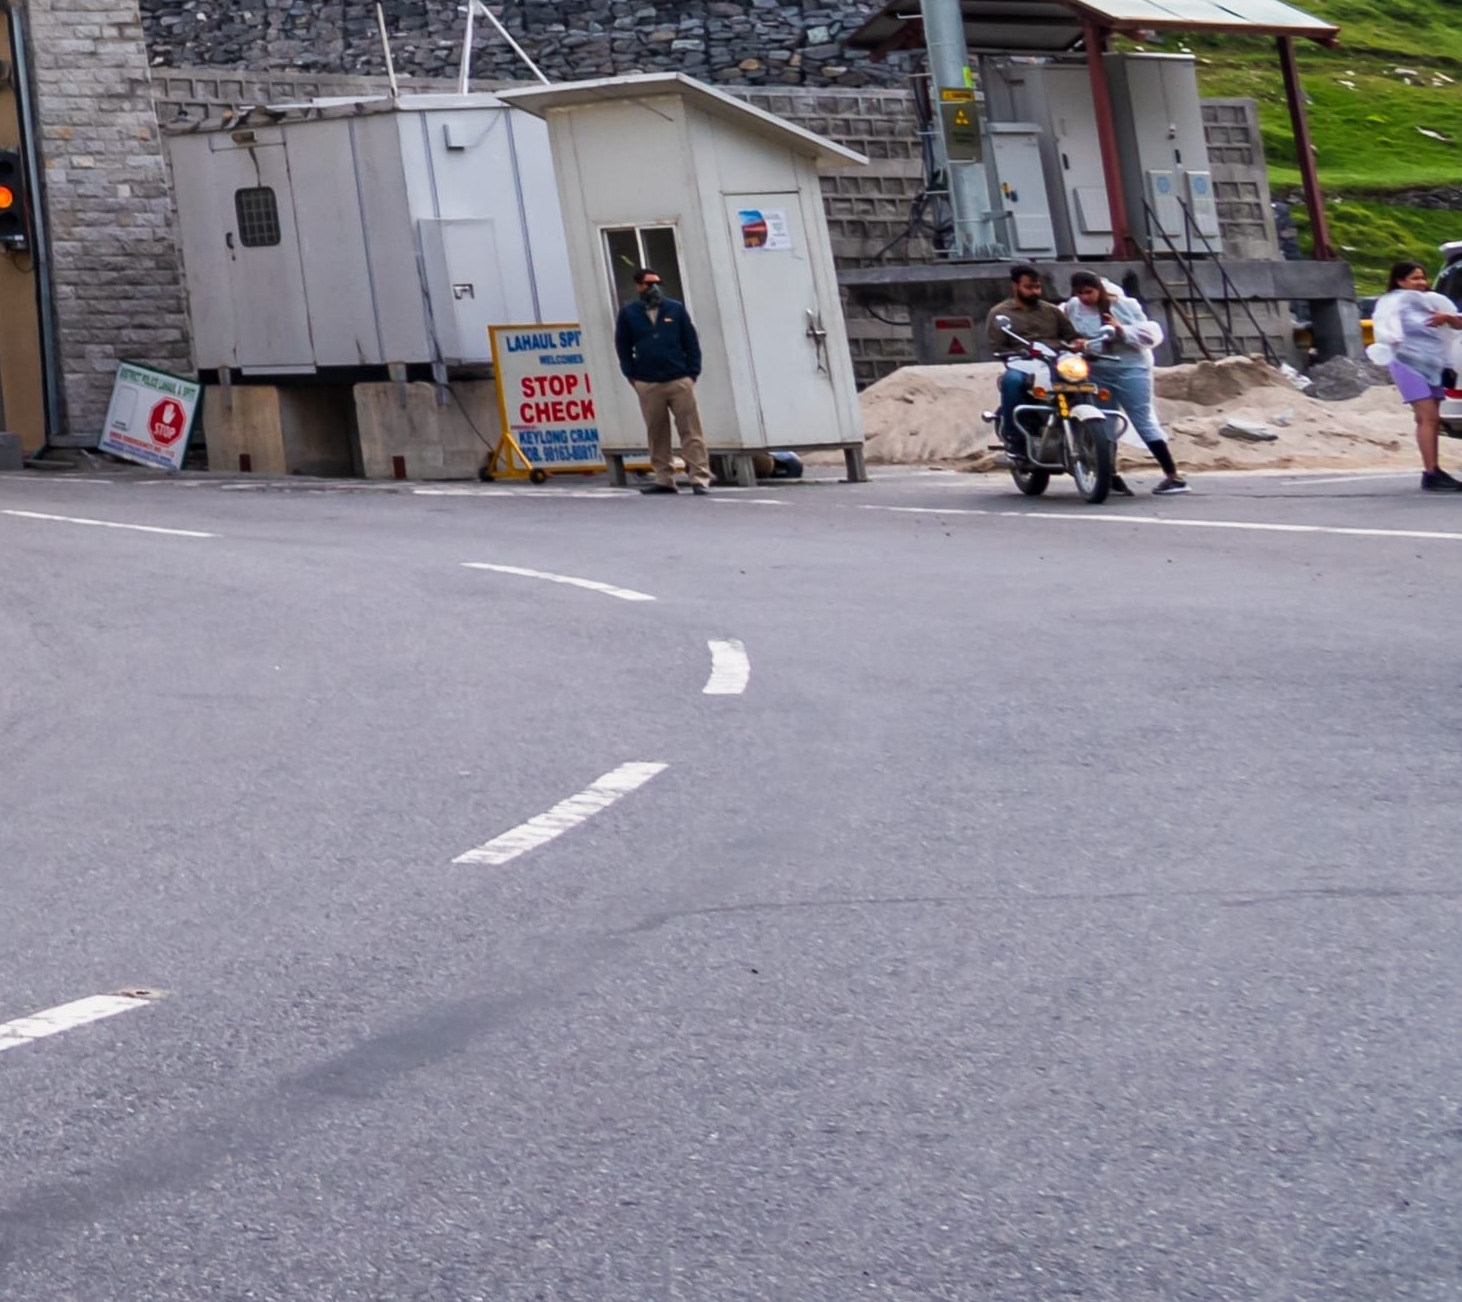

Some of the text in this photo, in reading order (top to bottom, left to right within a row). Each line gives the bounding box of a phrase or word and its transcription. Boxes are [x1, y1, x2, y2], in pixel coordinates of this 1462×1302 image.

[506, 332, 557, 353] LAHAUL
[521, 374, 579, 398] STOP
[520, 399, 596, 424] CHECK
[154, 422, 176, 439] STOP
[519, 430, 569, 446] KEYLONG
